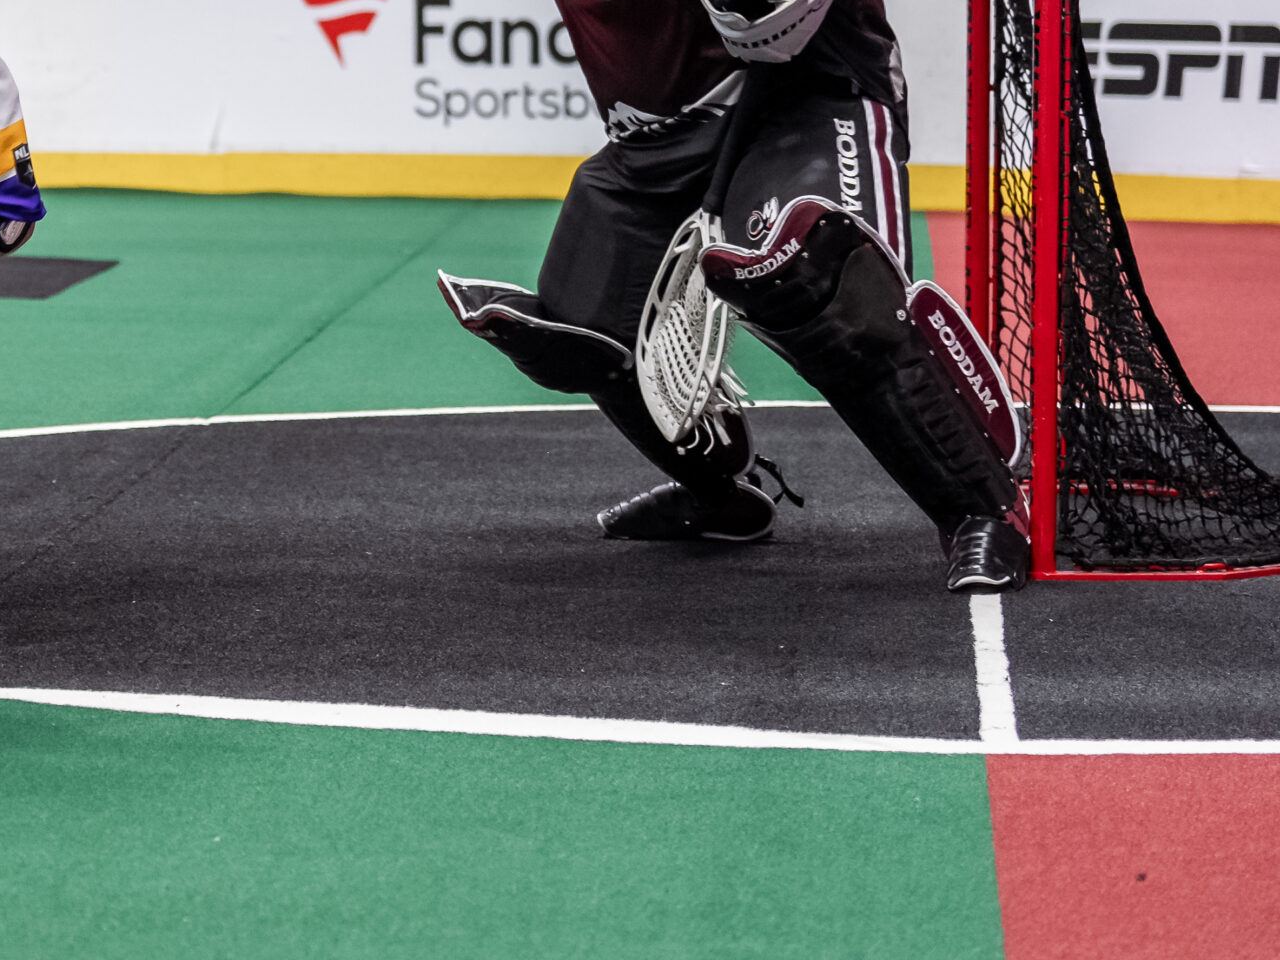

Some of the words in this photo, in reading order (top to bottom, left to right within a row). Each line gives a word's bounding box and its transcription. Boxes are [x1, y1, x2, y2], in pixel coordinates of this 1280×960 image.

[414, 78, 598, 127] Sportsb
[734, 237, 801, 280] BODDAM
[928, 309, 999, 414] BODDAM
